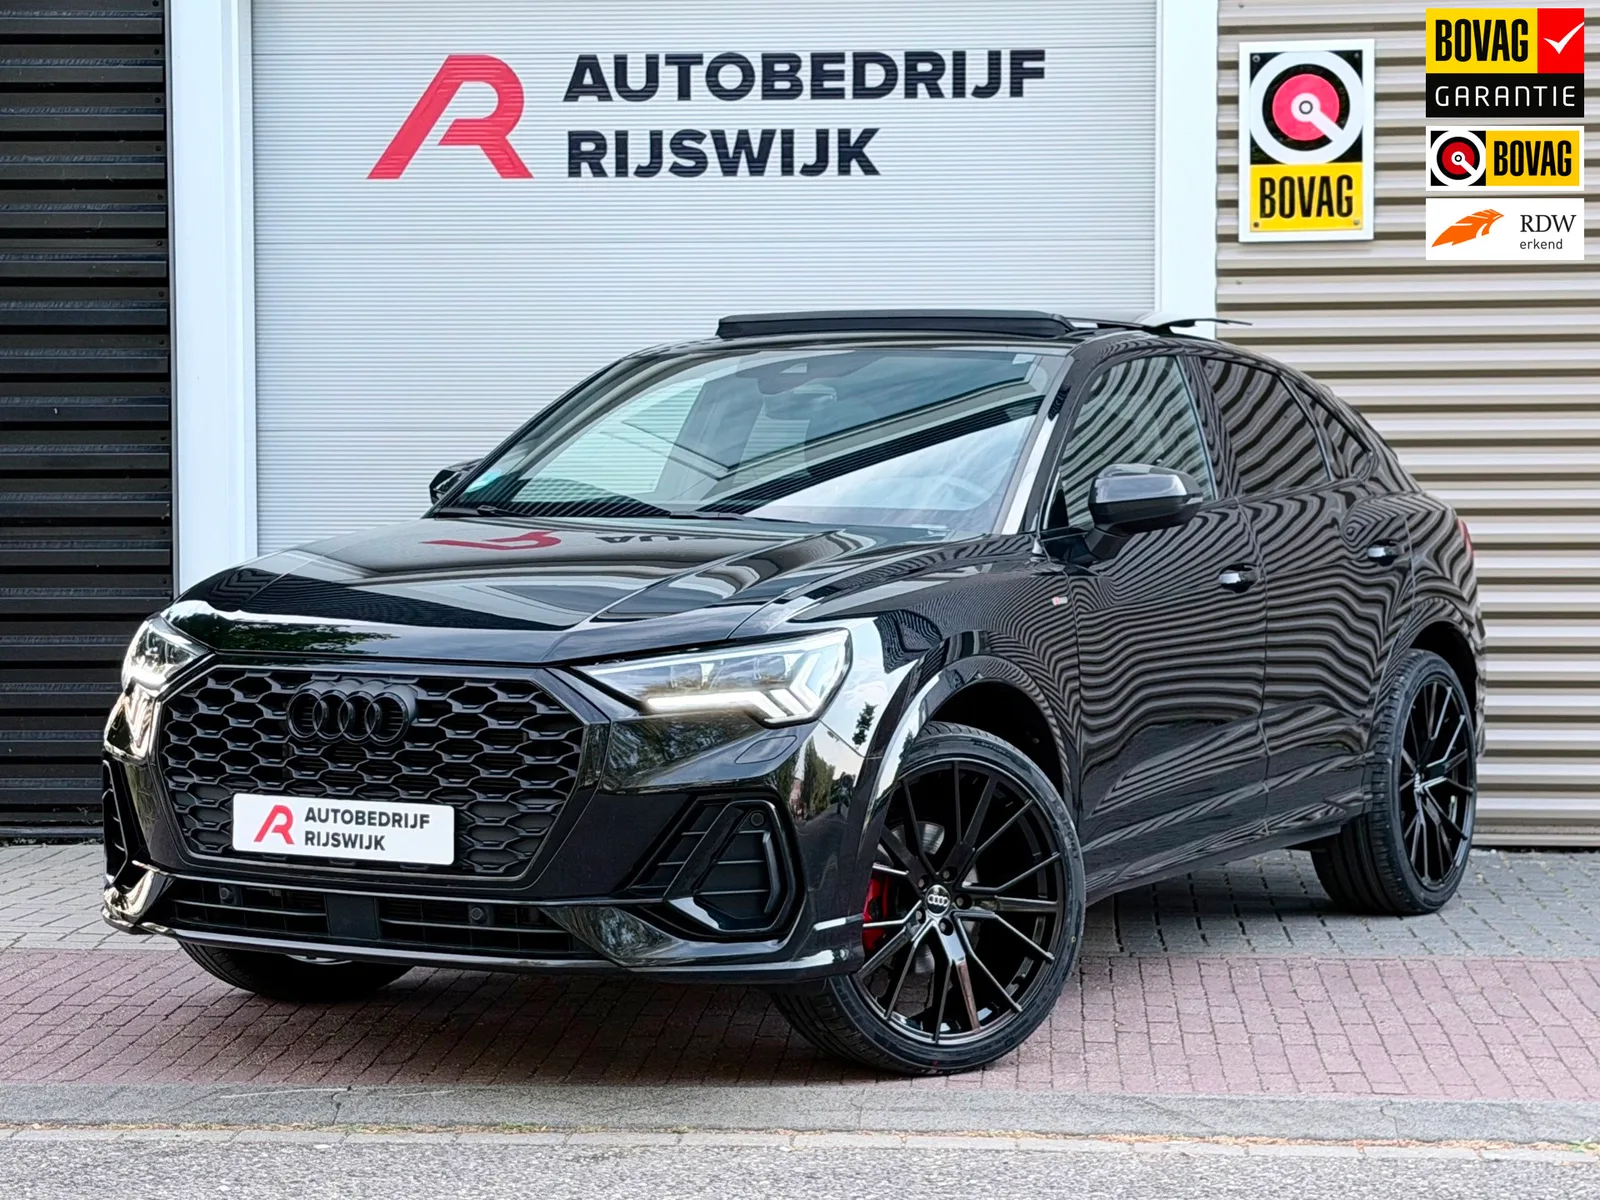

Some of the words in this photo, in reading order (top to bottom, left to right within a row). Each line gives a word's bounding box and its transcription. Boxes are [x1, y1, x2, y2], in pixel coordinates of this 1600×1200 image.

[564, 49, 1046, 102] AUTOBEDRIJF
[567, 128, 881, 178] RIJSWIJK
[1259, 174, 1354, 219] BOVAG
[304, 806, 430, 830] AUTOBEDRIJF
[304, 830, 386, 851] RIJSWIJK
